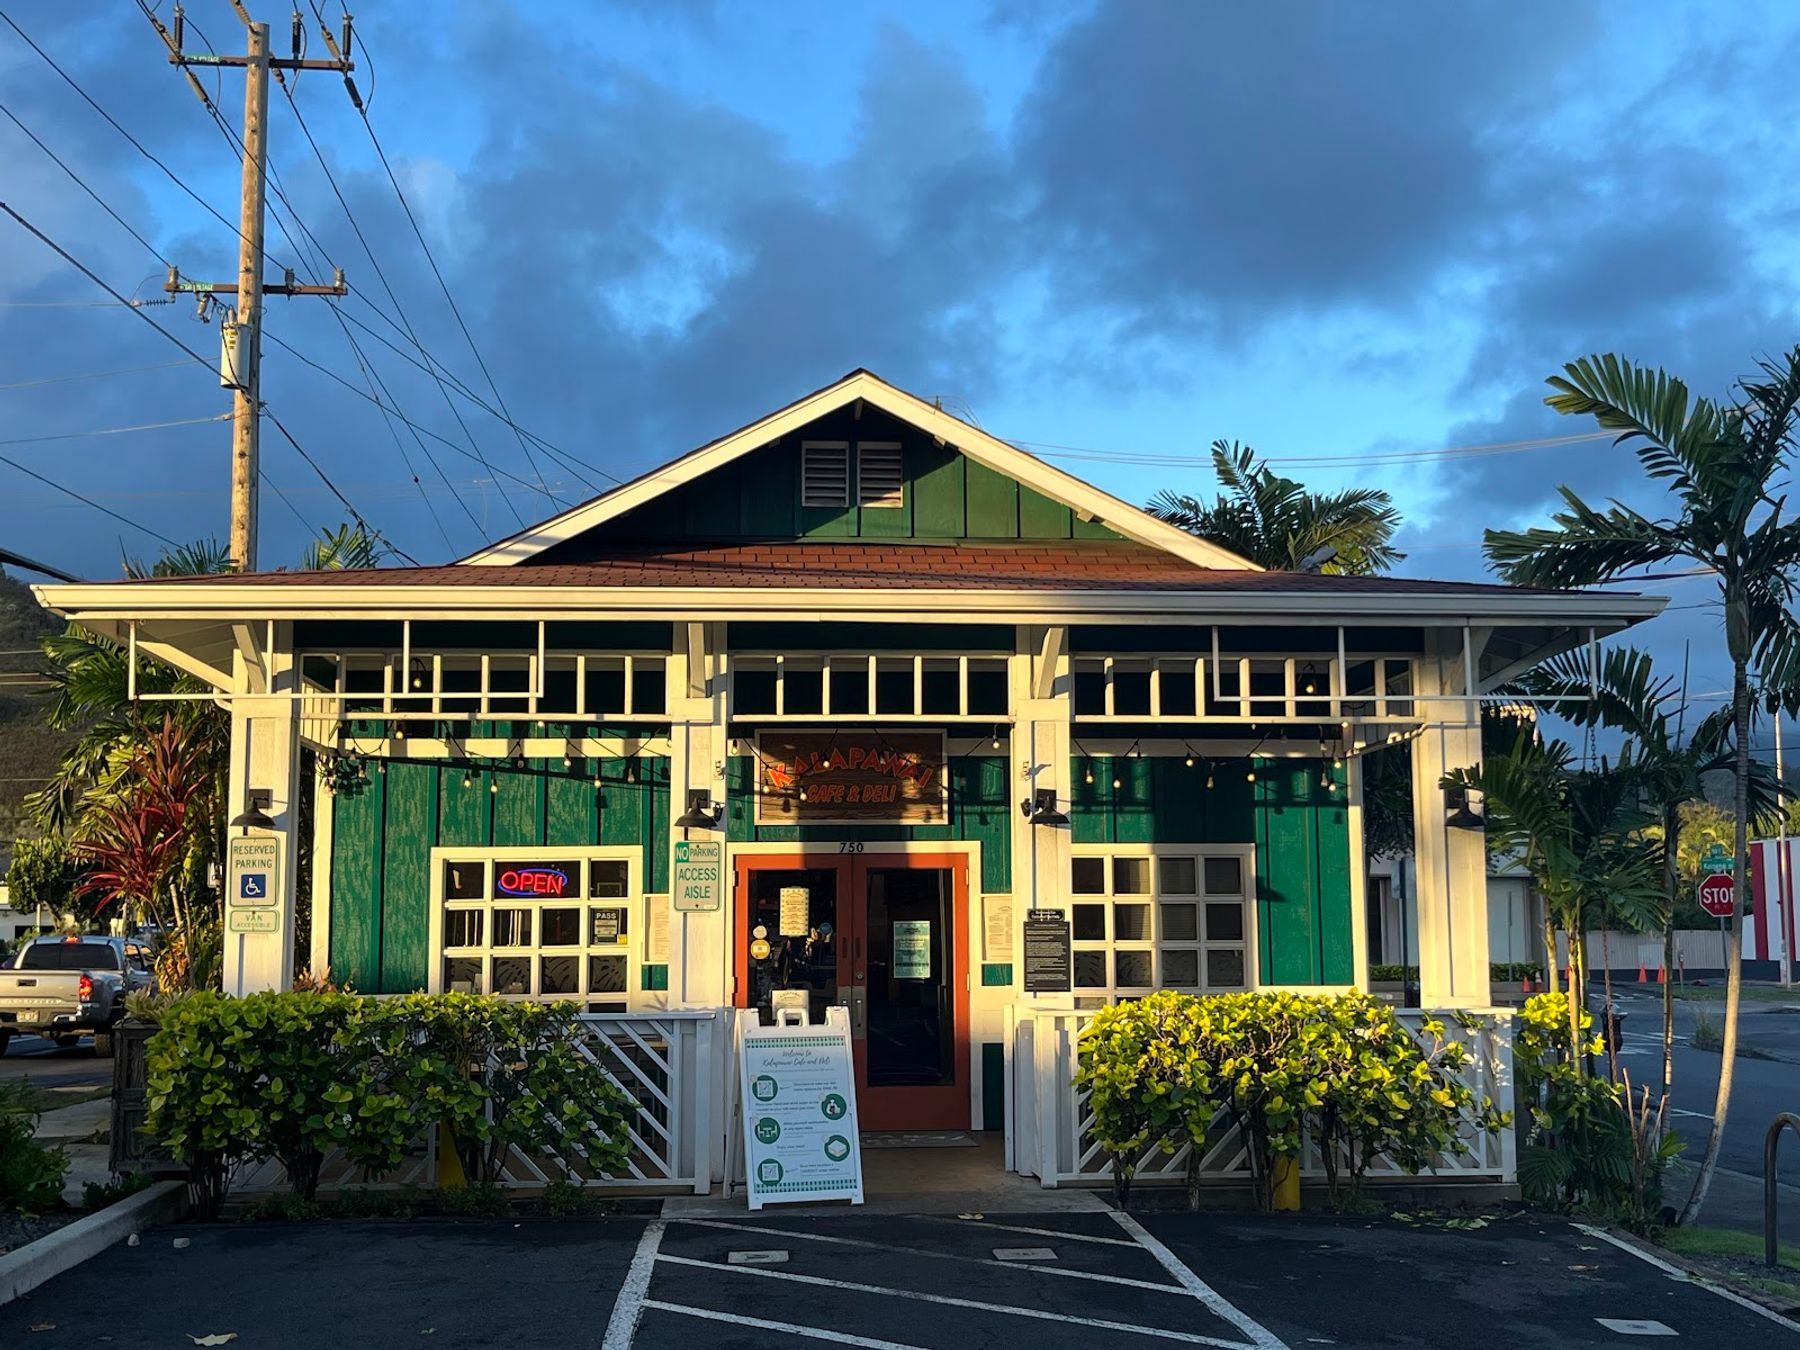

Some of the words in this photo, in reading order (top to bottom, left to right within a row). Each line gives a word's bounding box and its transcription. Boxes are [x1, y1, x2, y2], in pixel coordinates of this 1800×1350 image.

[768, 746, 933, 789] KALAPAWAI
[807, 784, 845, 803] CAFE
[848, 784, 861, 803] &
[863, 784, 897, 802] DELI
[233, 845, 275, 855] RESERVED
[676, 847, 689, 860] NO
[690, 848, 718, 857] PARKING
[840, 842, 864, 853] 750
[235, 860, 273, 868] PARKING
[678, 868, 717, 881] ACCESS
[501, 871, 563, 895] OPEN
[684, 886, 711, 899] AISLE
[245, 914, 263, 922] VAN
[596, 912, 617, 920] PASS
